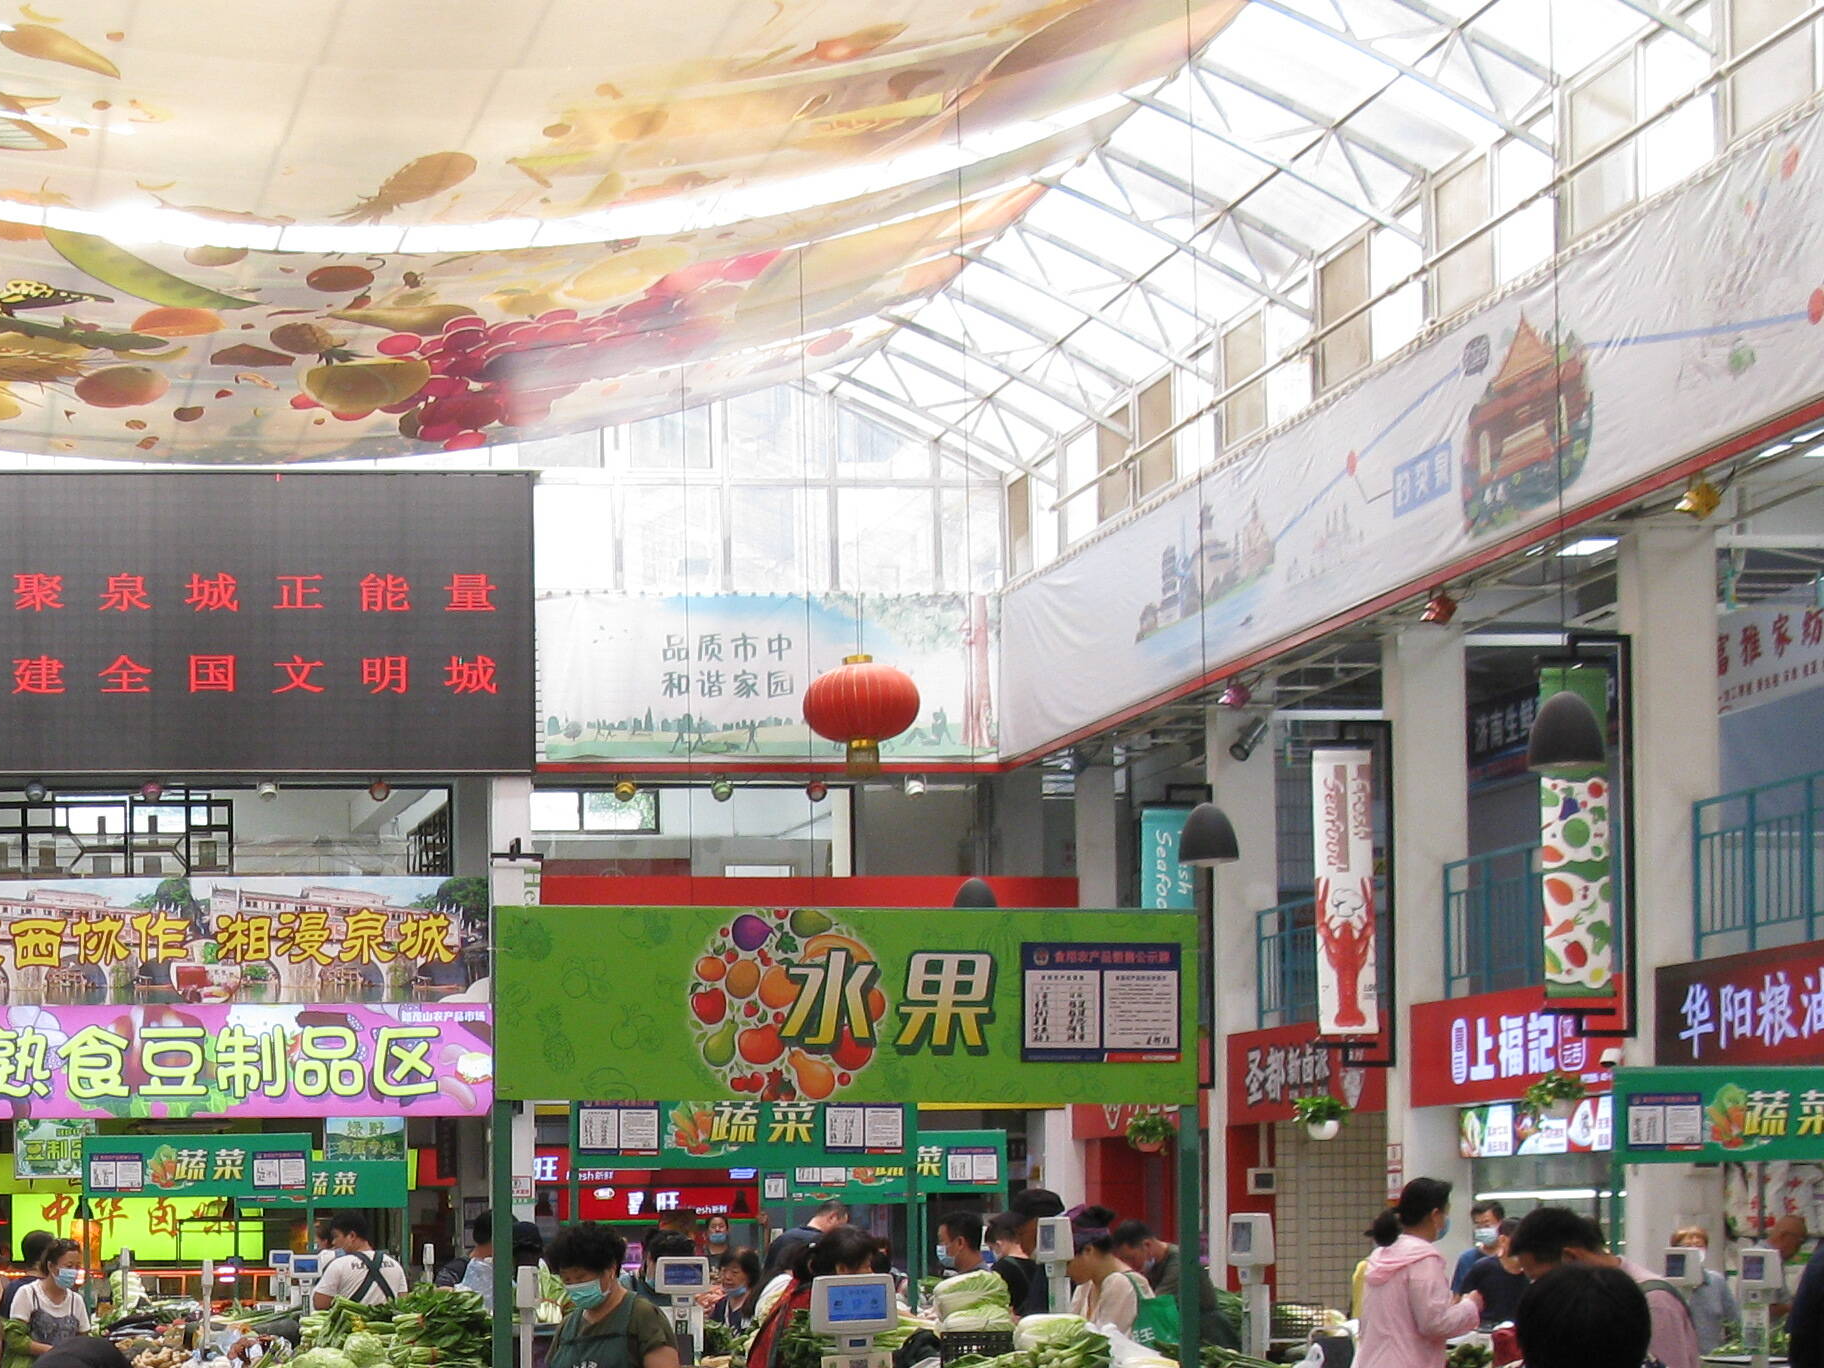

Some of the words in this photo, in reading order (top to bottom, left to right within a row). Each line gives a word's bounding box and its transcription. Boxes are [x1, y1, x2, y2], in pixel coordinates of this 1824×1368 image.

[661, 633, 793, 663] 品质市中
[661, 670, 795, 700] 和谐家园
[1352, 765, 1372, 840] Fresh
[1155, 829, 1172, 909] Seafoo
[216, 909, 458, 965] 湘漫泉城
[782, 949, 991, 1049] 水果
[1470, 1011, 1555, 1081] 上福記
[711, 1100, 815, 1143] 蔬菜
[1744, 1088, 1824, 1136] 蔬菜
[175, 1149, 245, 1181] 蔬菜
